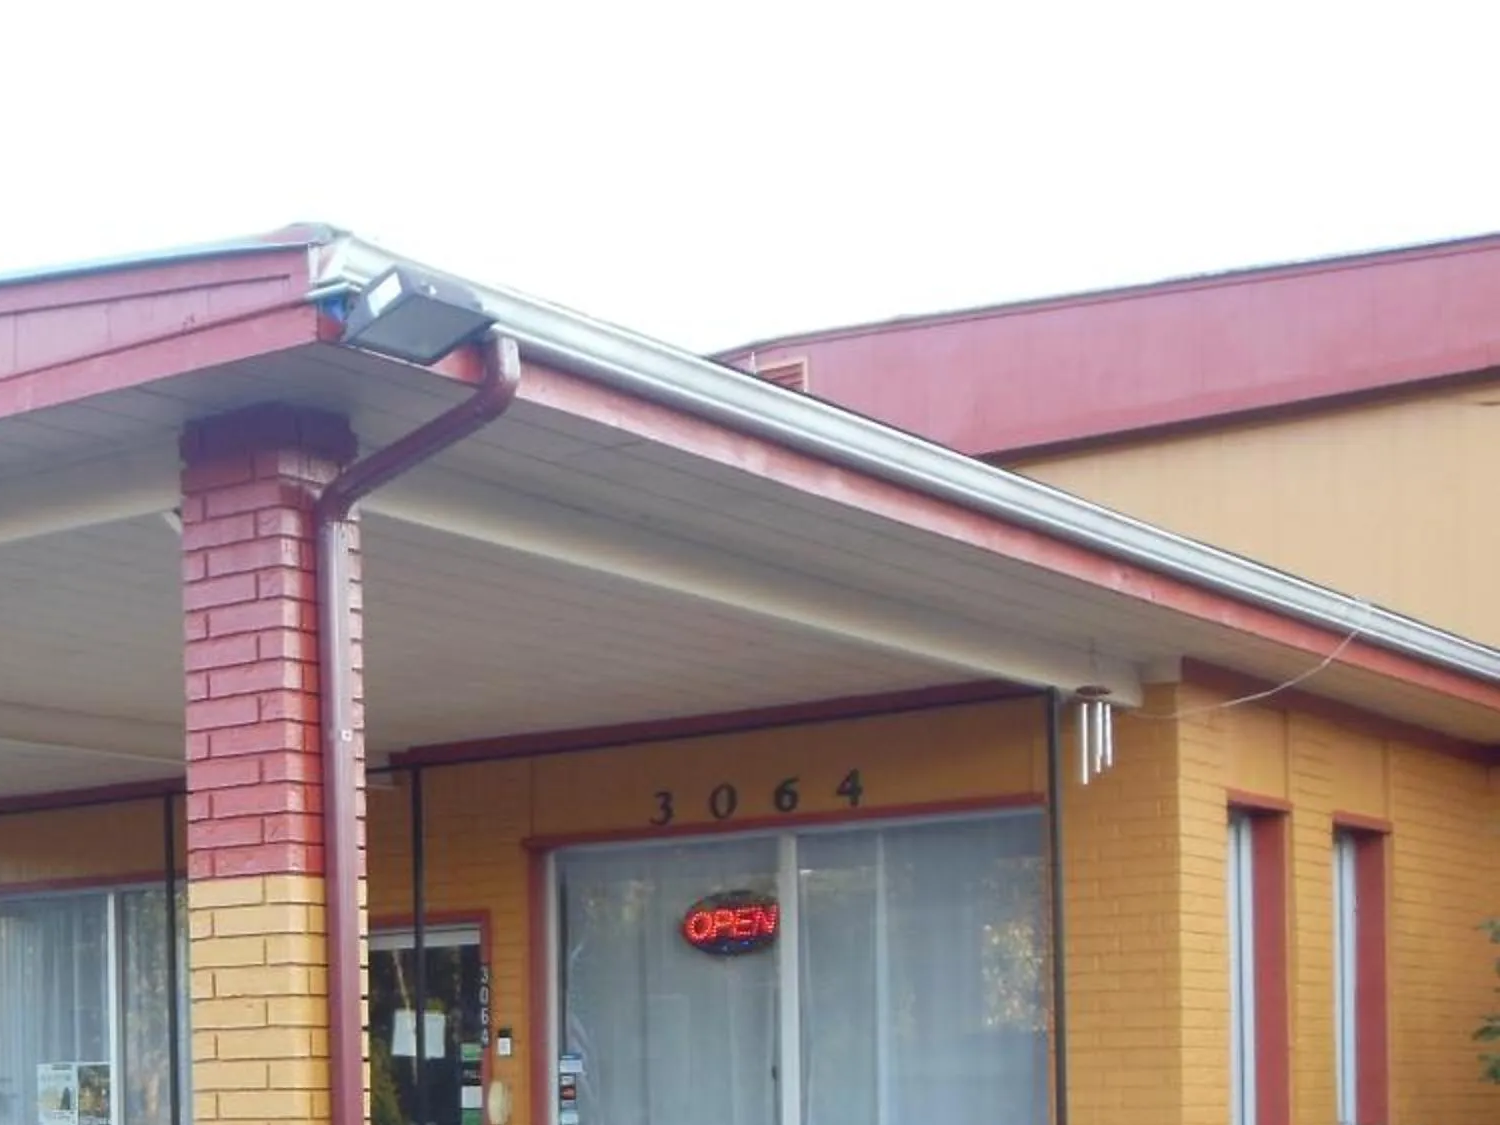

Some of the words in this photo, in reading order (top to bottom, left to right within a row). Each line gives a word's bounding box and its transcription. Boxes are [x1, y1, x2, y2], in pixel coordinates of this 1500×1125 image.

[650, 768, 863, 827] 3064
[688, 903, 777, 940] OPEN
[479, 965, 489, 1045] 3064
